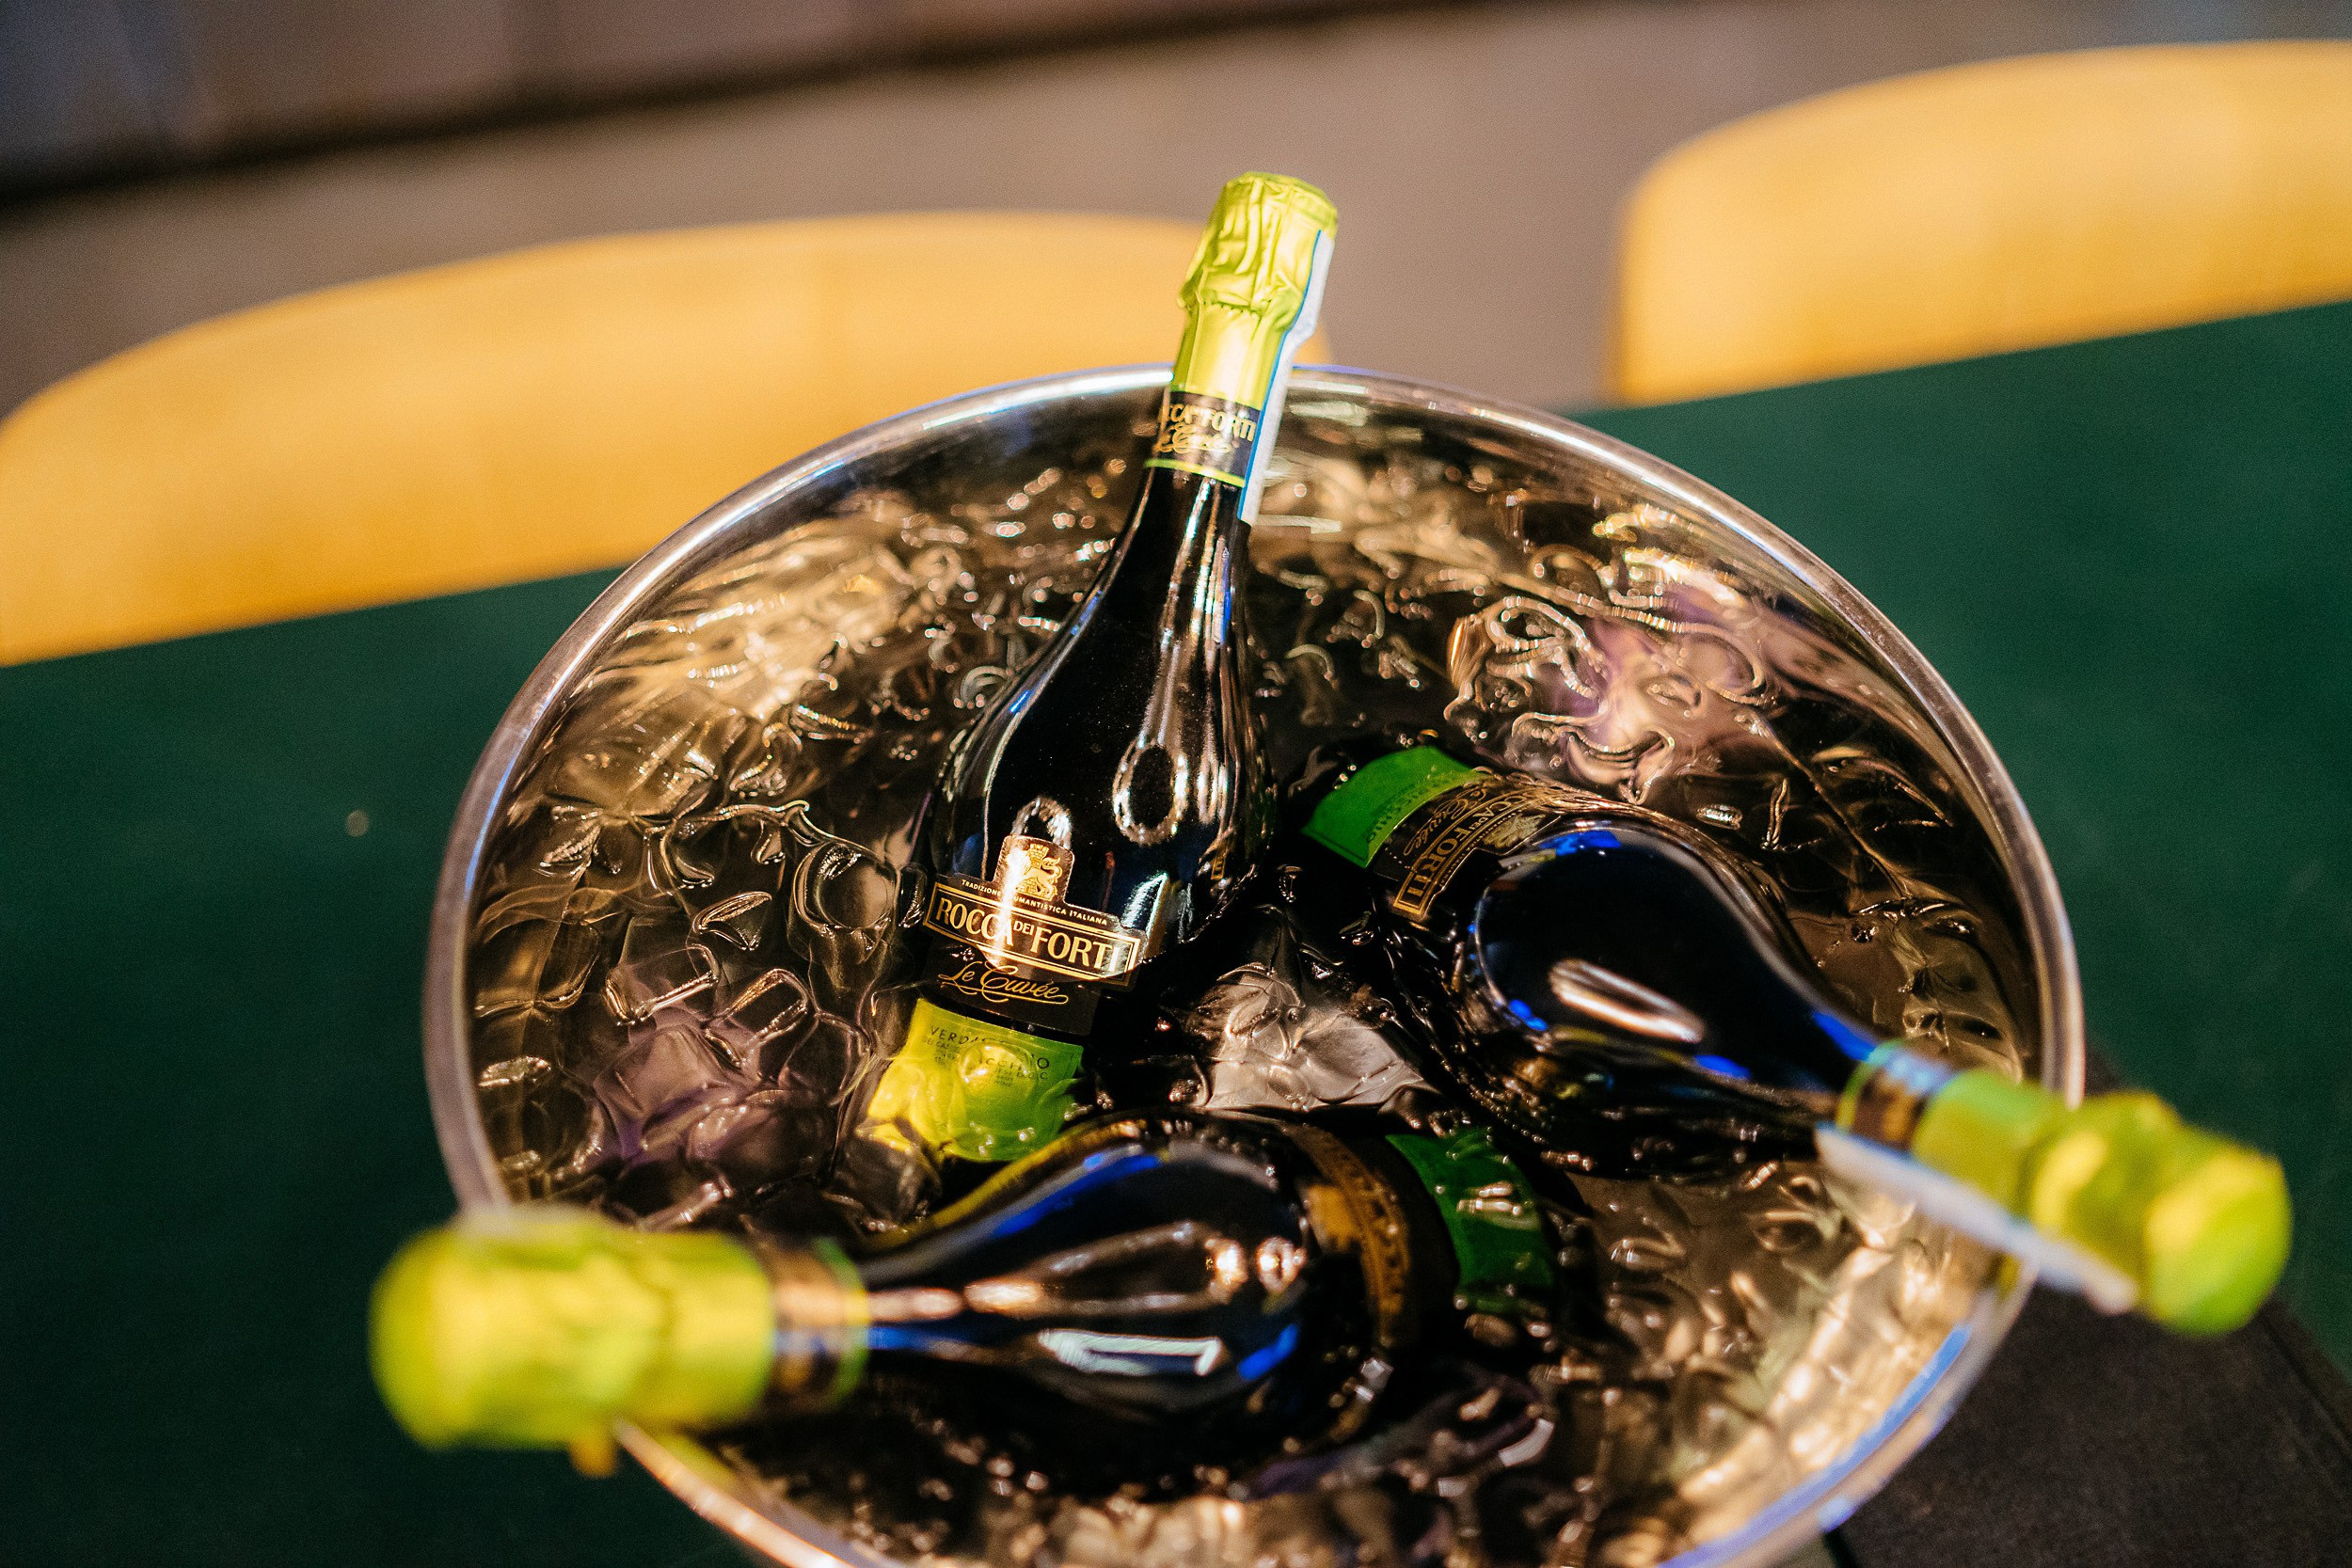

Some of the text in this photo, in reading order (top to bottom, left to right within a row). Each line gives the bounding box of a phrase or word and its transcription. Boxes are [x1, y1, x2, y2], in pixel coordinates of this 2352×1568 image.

[1407, 827, 1471, 896] FORTI
[961, 879, 1107, 927] TRADIZIONE UMANTISTICA ITALIANA
[936, 896, 1118, 973] ROCCA DEI FORTI
[938, 960, 1069, 1005] Le Cuvée
